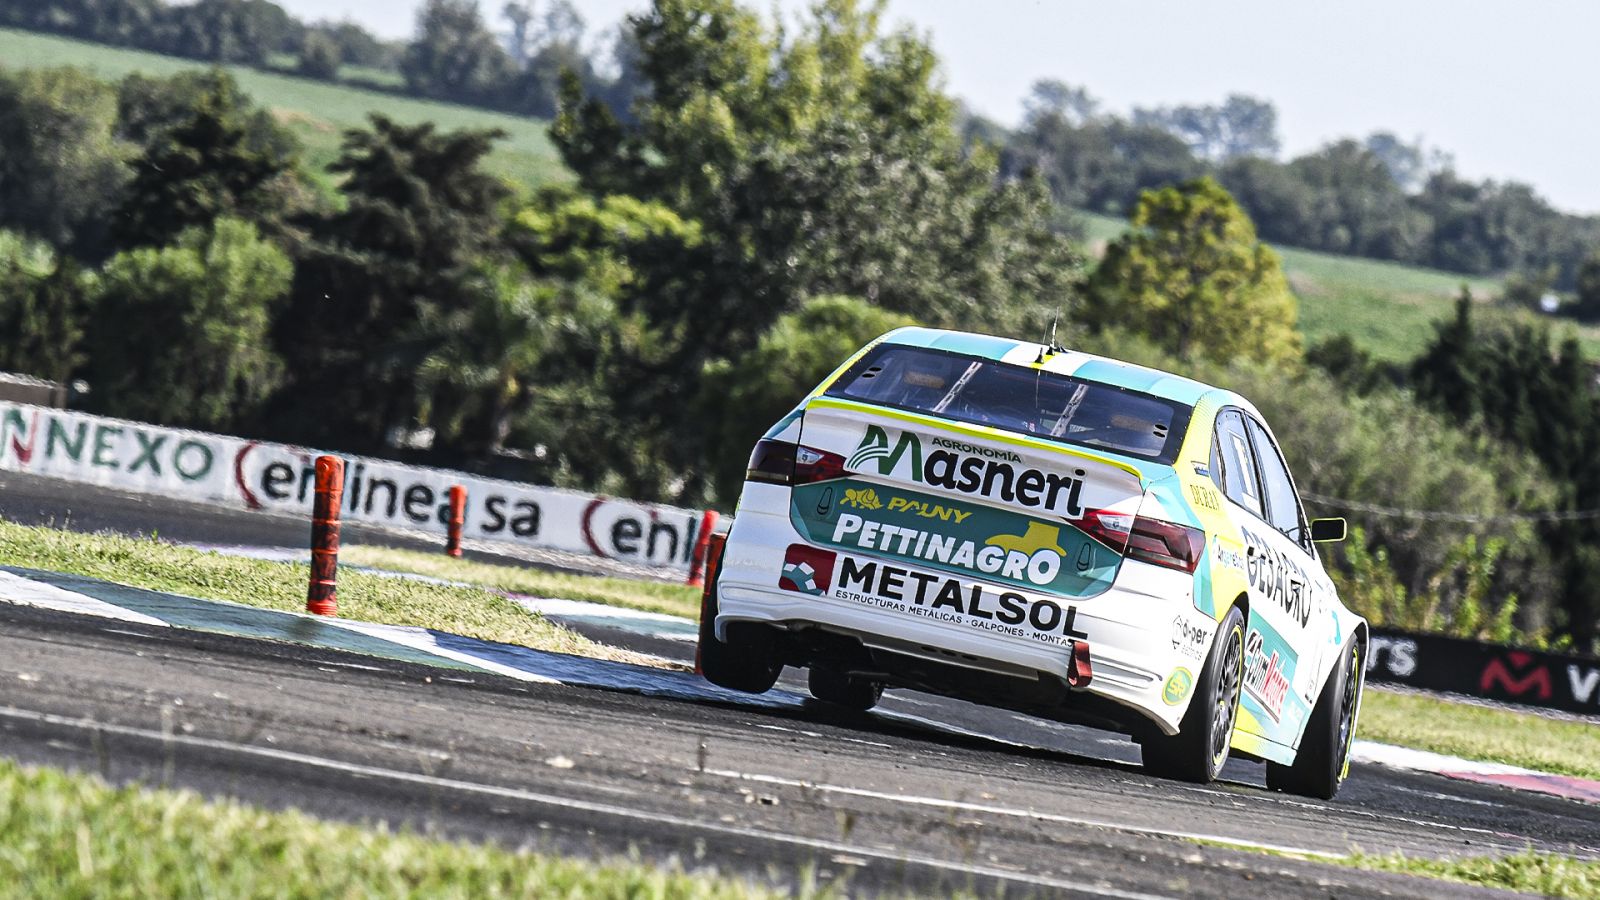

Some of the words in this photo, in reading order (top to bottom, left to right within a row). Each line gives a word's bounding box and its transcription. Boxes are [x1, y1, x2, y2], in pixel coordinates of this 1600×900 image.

[847, 424, 1086, 517] Masneri
[931, 437, 1022, 464] AGRONOMÍA
[261, 460, 468, 536] eine
[481, 493, 541, 537] sa
[887, 497, 973, 524] PAUNY
[832, 513, 1061, 585] PETTINAGRO
[835, 589, 906, 612] ESTRUCTURAS
[908, 605, 963, 624] METÁLICAS
[971, 619, 1024, 637] GALPONES
[838, 557, 1089, 640] METALSOL
